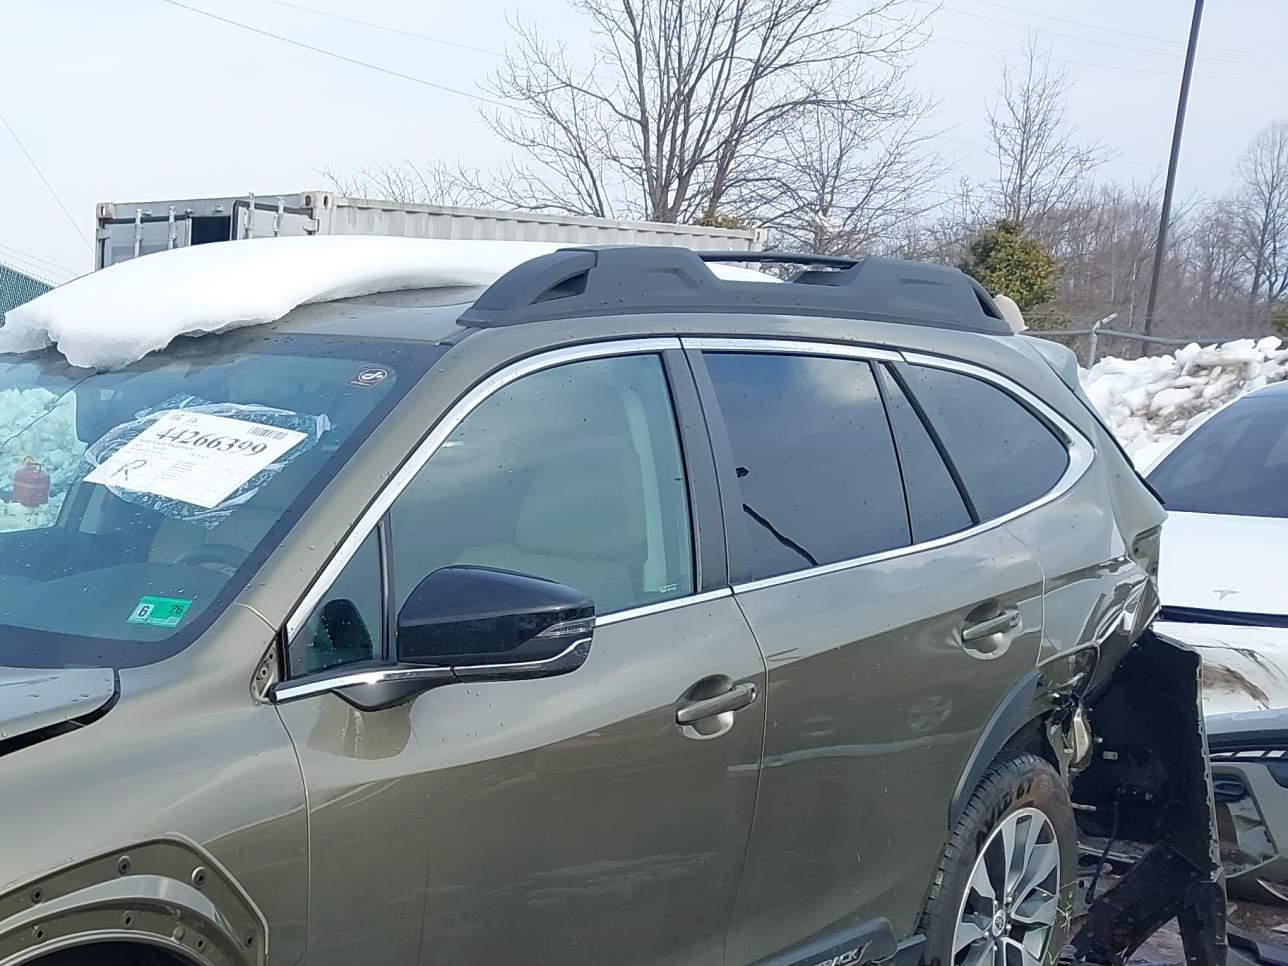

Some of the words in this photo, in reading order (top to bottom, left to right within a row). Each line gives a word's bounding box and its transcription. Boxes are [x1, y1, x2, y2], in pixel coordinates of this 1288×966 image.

[155, 426, 268, 457] 44266399
[138, 605, 150, 618] 6
[168, 604, 185, 615] 26
